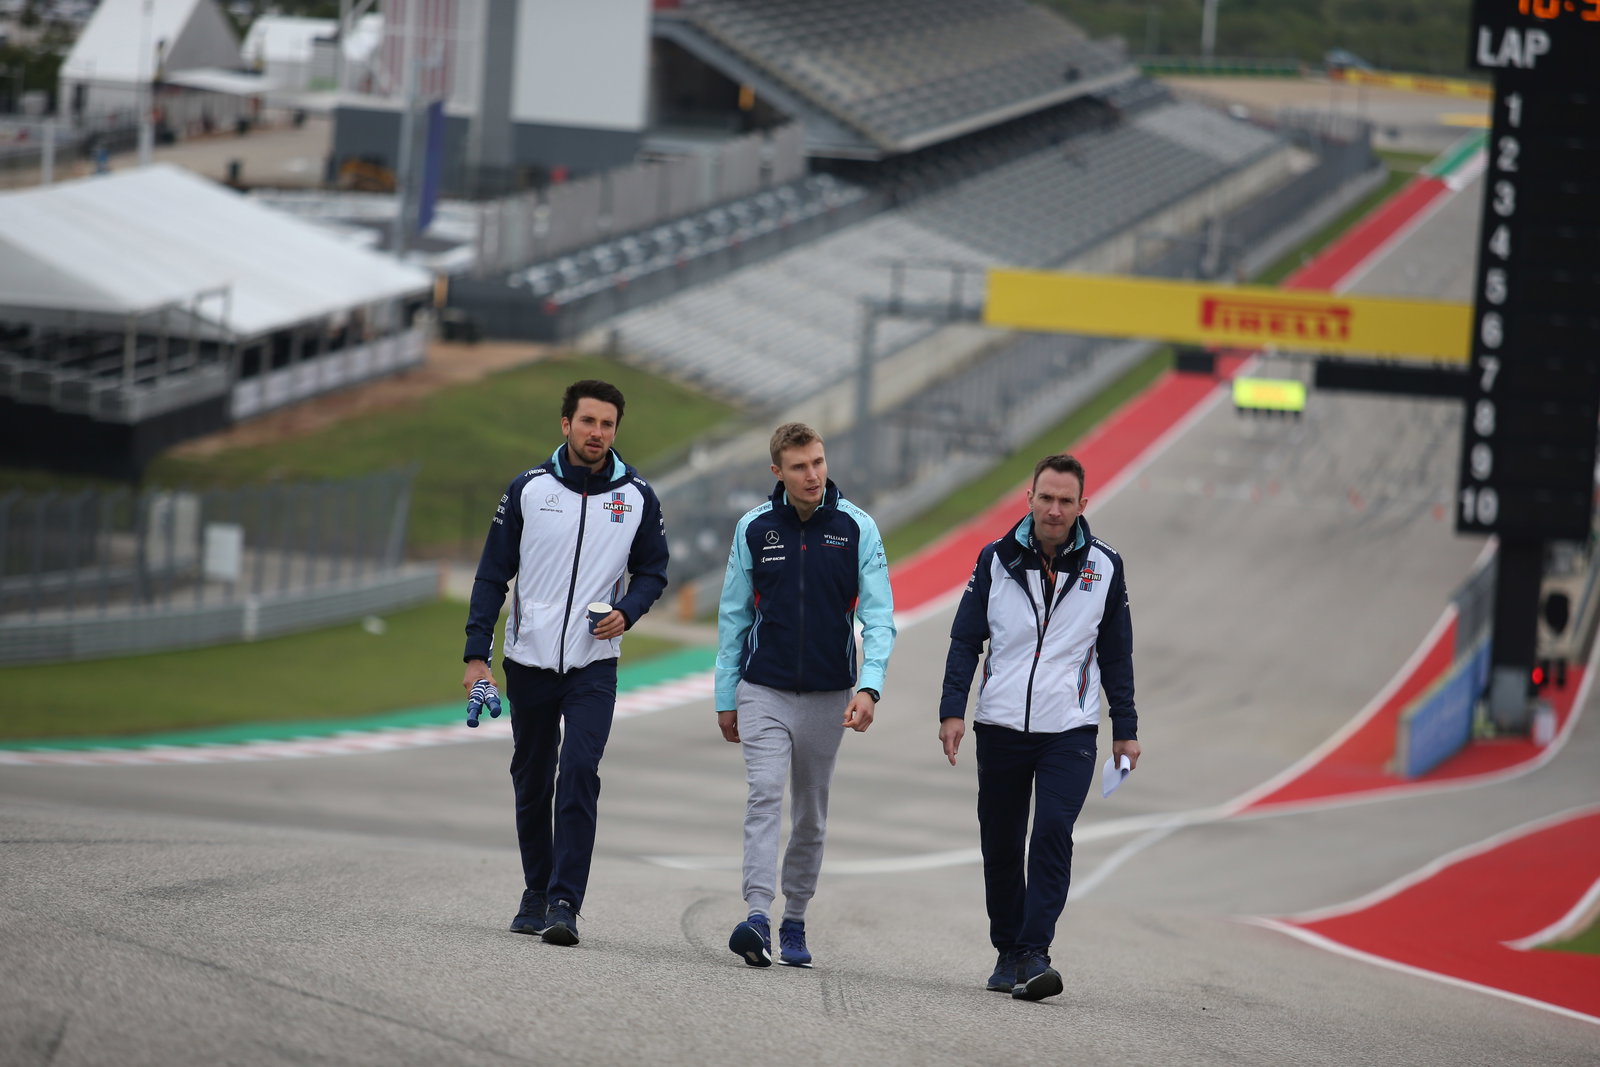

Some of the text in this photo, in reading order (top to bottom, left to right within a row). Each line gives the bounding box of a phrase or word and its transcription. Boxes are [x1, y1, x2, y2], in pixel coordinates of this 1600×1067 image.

[1477, 25, 1551, 69] LAP
[1504, 91, 1522, 128] 1
[1497, 136, 1520, 172] 2
[1493, 180, 1516, 217] 3
[1488, 223, 1512, 261] 4
[1485, 268, 1507, 305] 5
[1200, 295, 1353, 342] PIRELLI
[1481, 311, 1504, 349] 6
[1478, 355, 1500, 393] 7
[1473, 399, 1496, 437] 8
[1470, 443, 1493, 481] 9
[604, 502, 632, 512] MARTINI
[1461, 485, 1499, 525] 10
[823, 534, 848, 542] WILLIAMS
[1080, 571, 1102, 580] ARTINI
